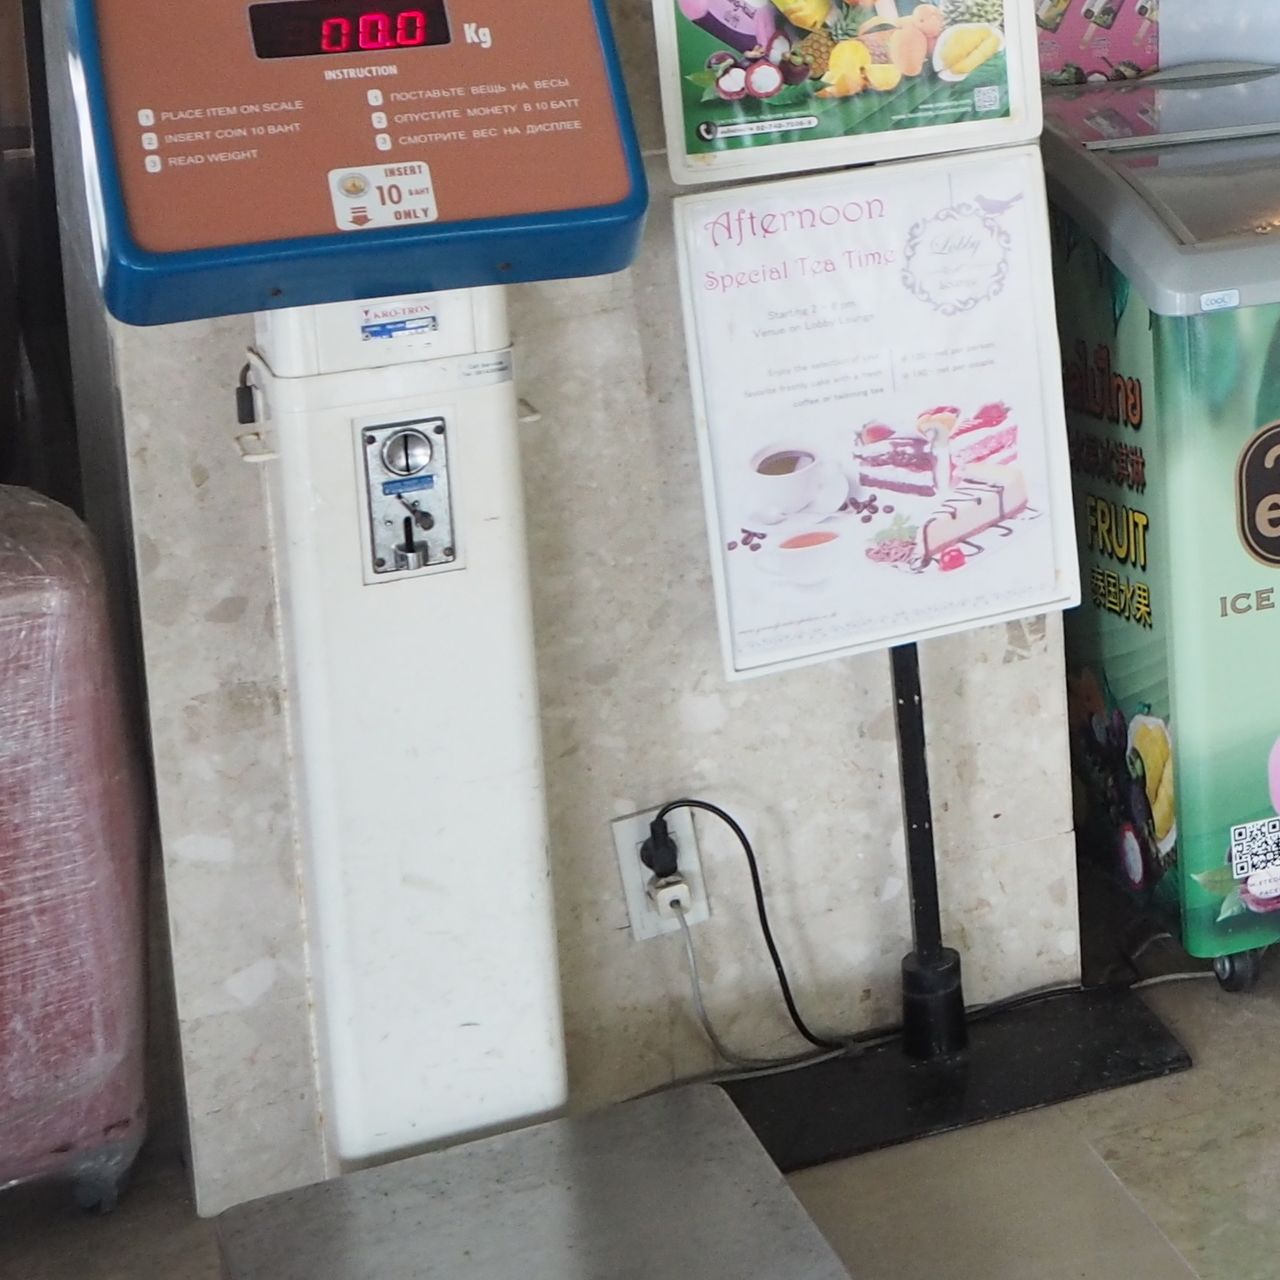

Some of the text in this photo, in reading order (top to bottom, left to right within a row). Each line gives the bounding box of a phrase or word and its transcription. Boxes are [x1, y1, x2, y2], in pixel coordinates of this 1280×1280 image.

[463, 23, 492, 48] Kg
[324, 65, 398, 80] INSTRUCTION
[511, 81, 529, 91] НА
[534, 78, 570, 89] ВЕСЫ
[160, 100, 304, 121] PLACE ITEM ON SCALE
[393, 109, 462, 124] ОПУСТИТЕ
[466, 104, 517, 117] МОНЕТУ
[523, 102, 533, 113] В
[535, 101, 549, 111] 10
[164, 131, 211, 144] INSERT
[215, 128, 247, 139] COIN
[251, 126, 264, 136] 10
[267, 122, 301, 135] BAHT
[398, 130, 468, 146] СМОТРИТЕ
[472, 127, 498, 139] ВЕС
[503, 125, 521, 137] НА
[526, 120, 583, 135] ДИСПЛЕЕ
[167, 154, 205, 167] READ
[207, 149, 259, 163] WEIGHT
[384, 164, 423, 178] INSERT
[375, 183, 403, 206] 10
[393, 208, 430, 221] ONLY
[703, 198, 886, 248] Afternoon
[703, 247, 897, 293] Special Tea Time
[752, 327, 787, 340] Venue
[804, 318, 837, 332] Lobby
[1086, 495, 1149, 572] FRUIT
[1219, 587, 1276, 618] ICE
